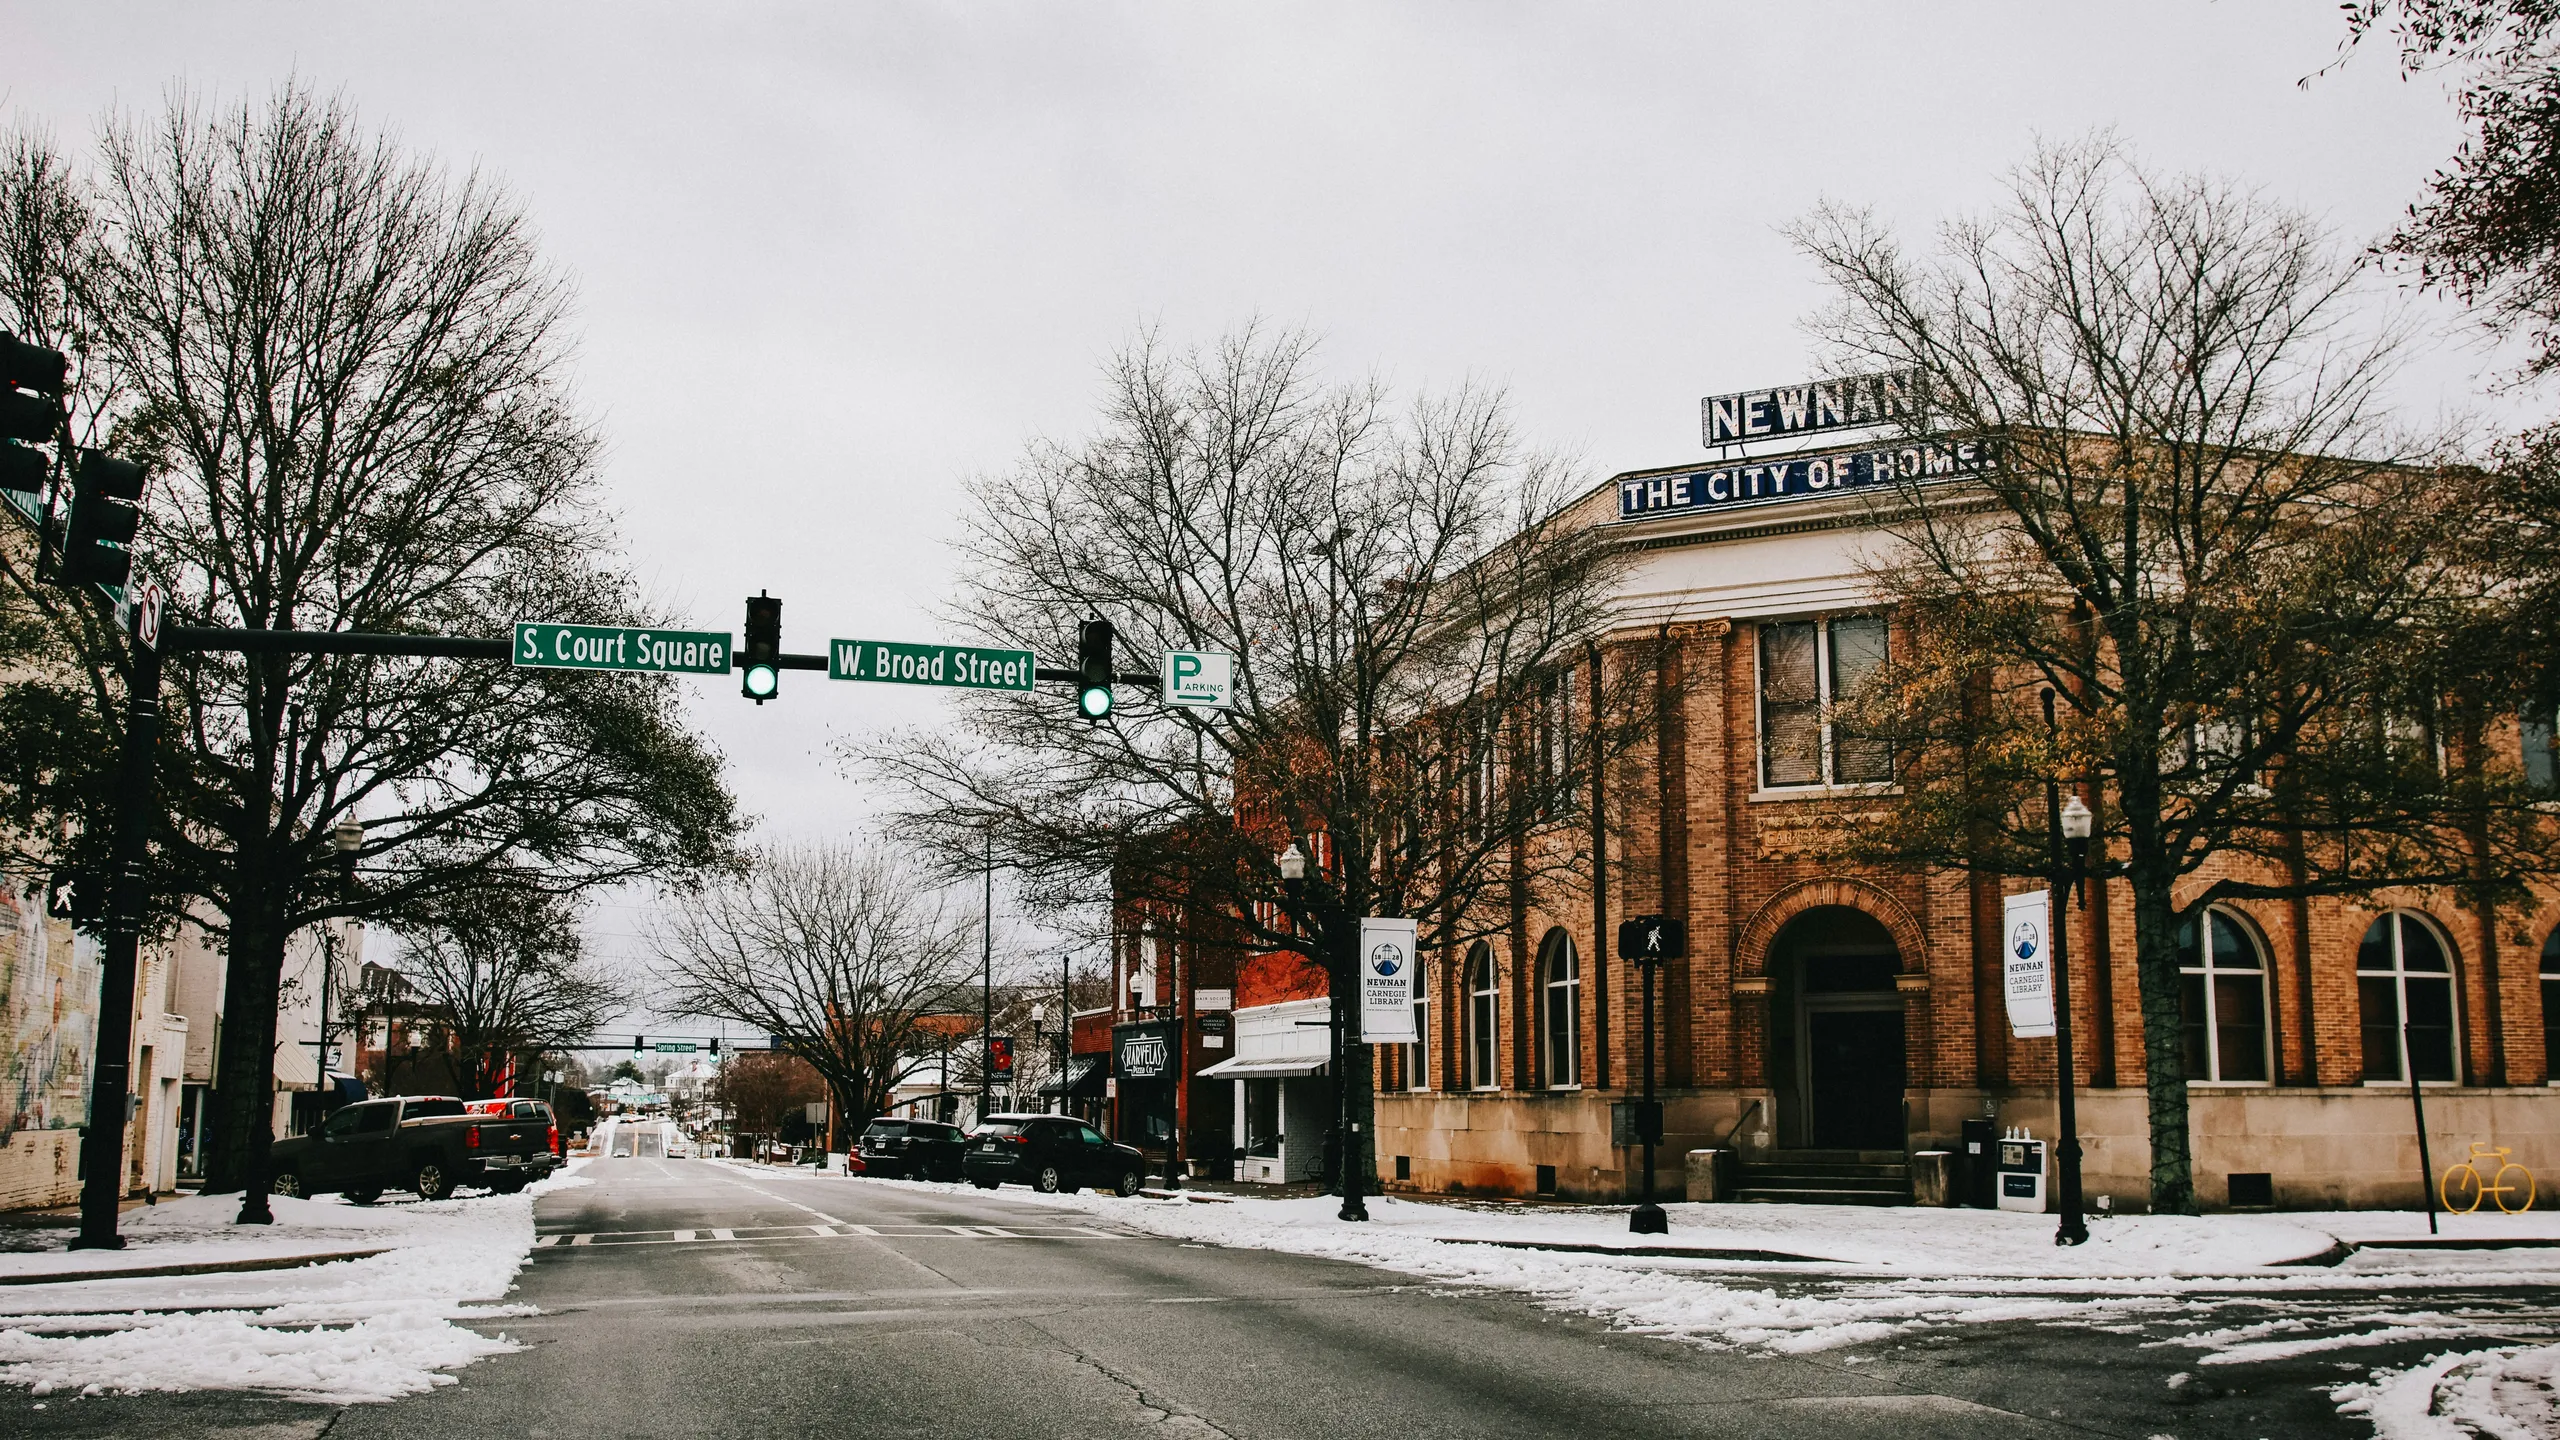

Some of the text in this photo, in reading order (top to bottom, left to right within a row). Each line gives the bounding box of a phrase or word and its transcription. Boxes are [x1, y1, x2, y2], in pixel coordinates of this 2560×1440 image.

[1625, 477, 1691, 511] THE
[1707, 464, 1790, 501] CITY
[1807, 456, 1853, 490] OF
[522, 627, 724, 670] S. Court Square
[837, 644, 1028, 687] W. Broad Street
[2009, 961, 2044, 973] NEWNAN
[1366, 978, 1407, 987] NEWNAN
[2009, 974, 2045, 986] CARNEGIE
[1366, 989, 1407, 998] CARNEGIE
[2012, 983, 2042, 994] LIBRARY
[1369, 997, 1404, 1006] LIBRARY
[657, 1044, 695, 1052] Spring Street
[1126, 1043, 1162, 1067] KARVELAS
[1132, 1065, 1145, 1074] Pizza
